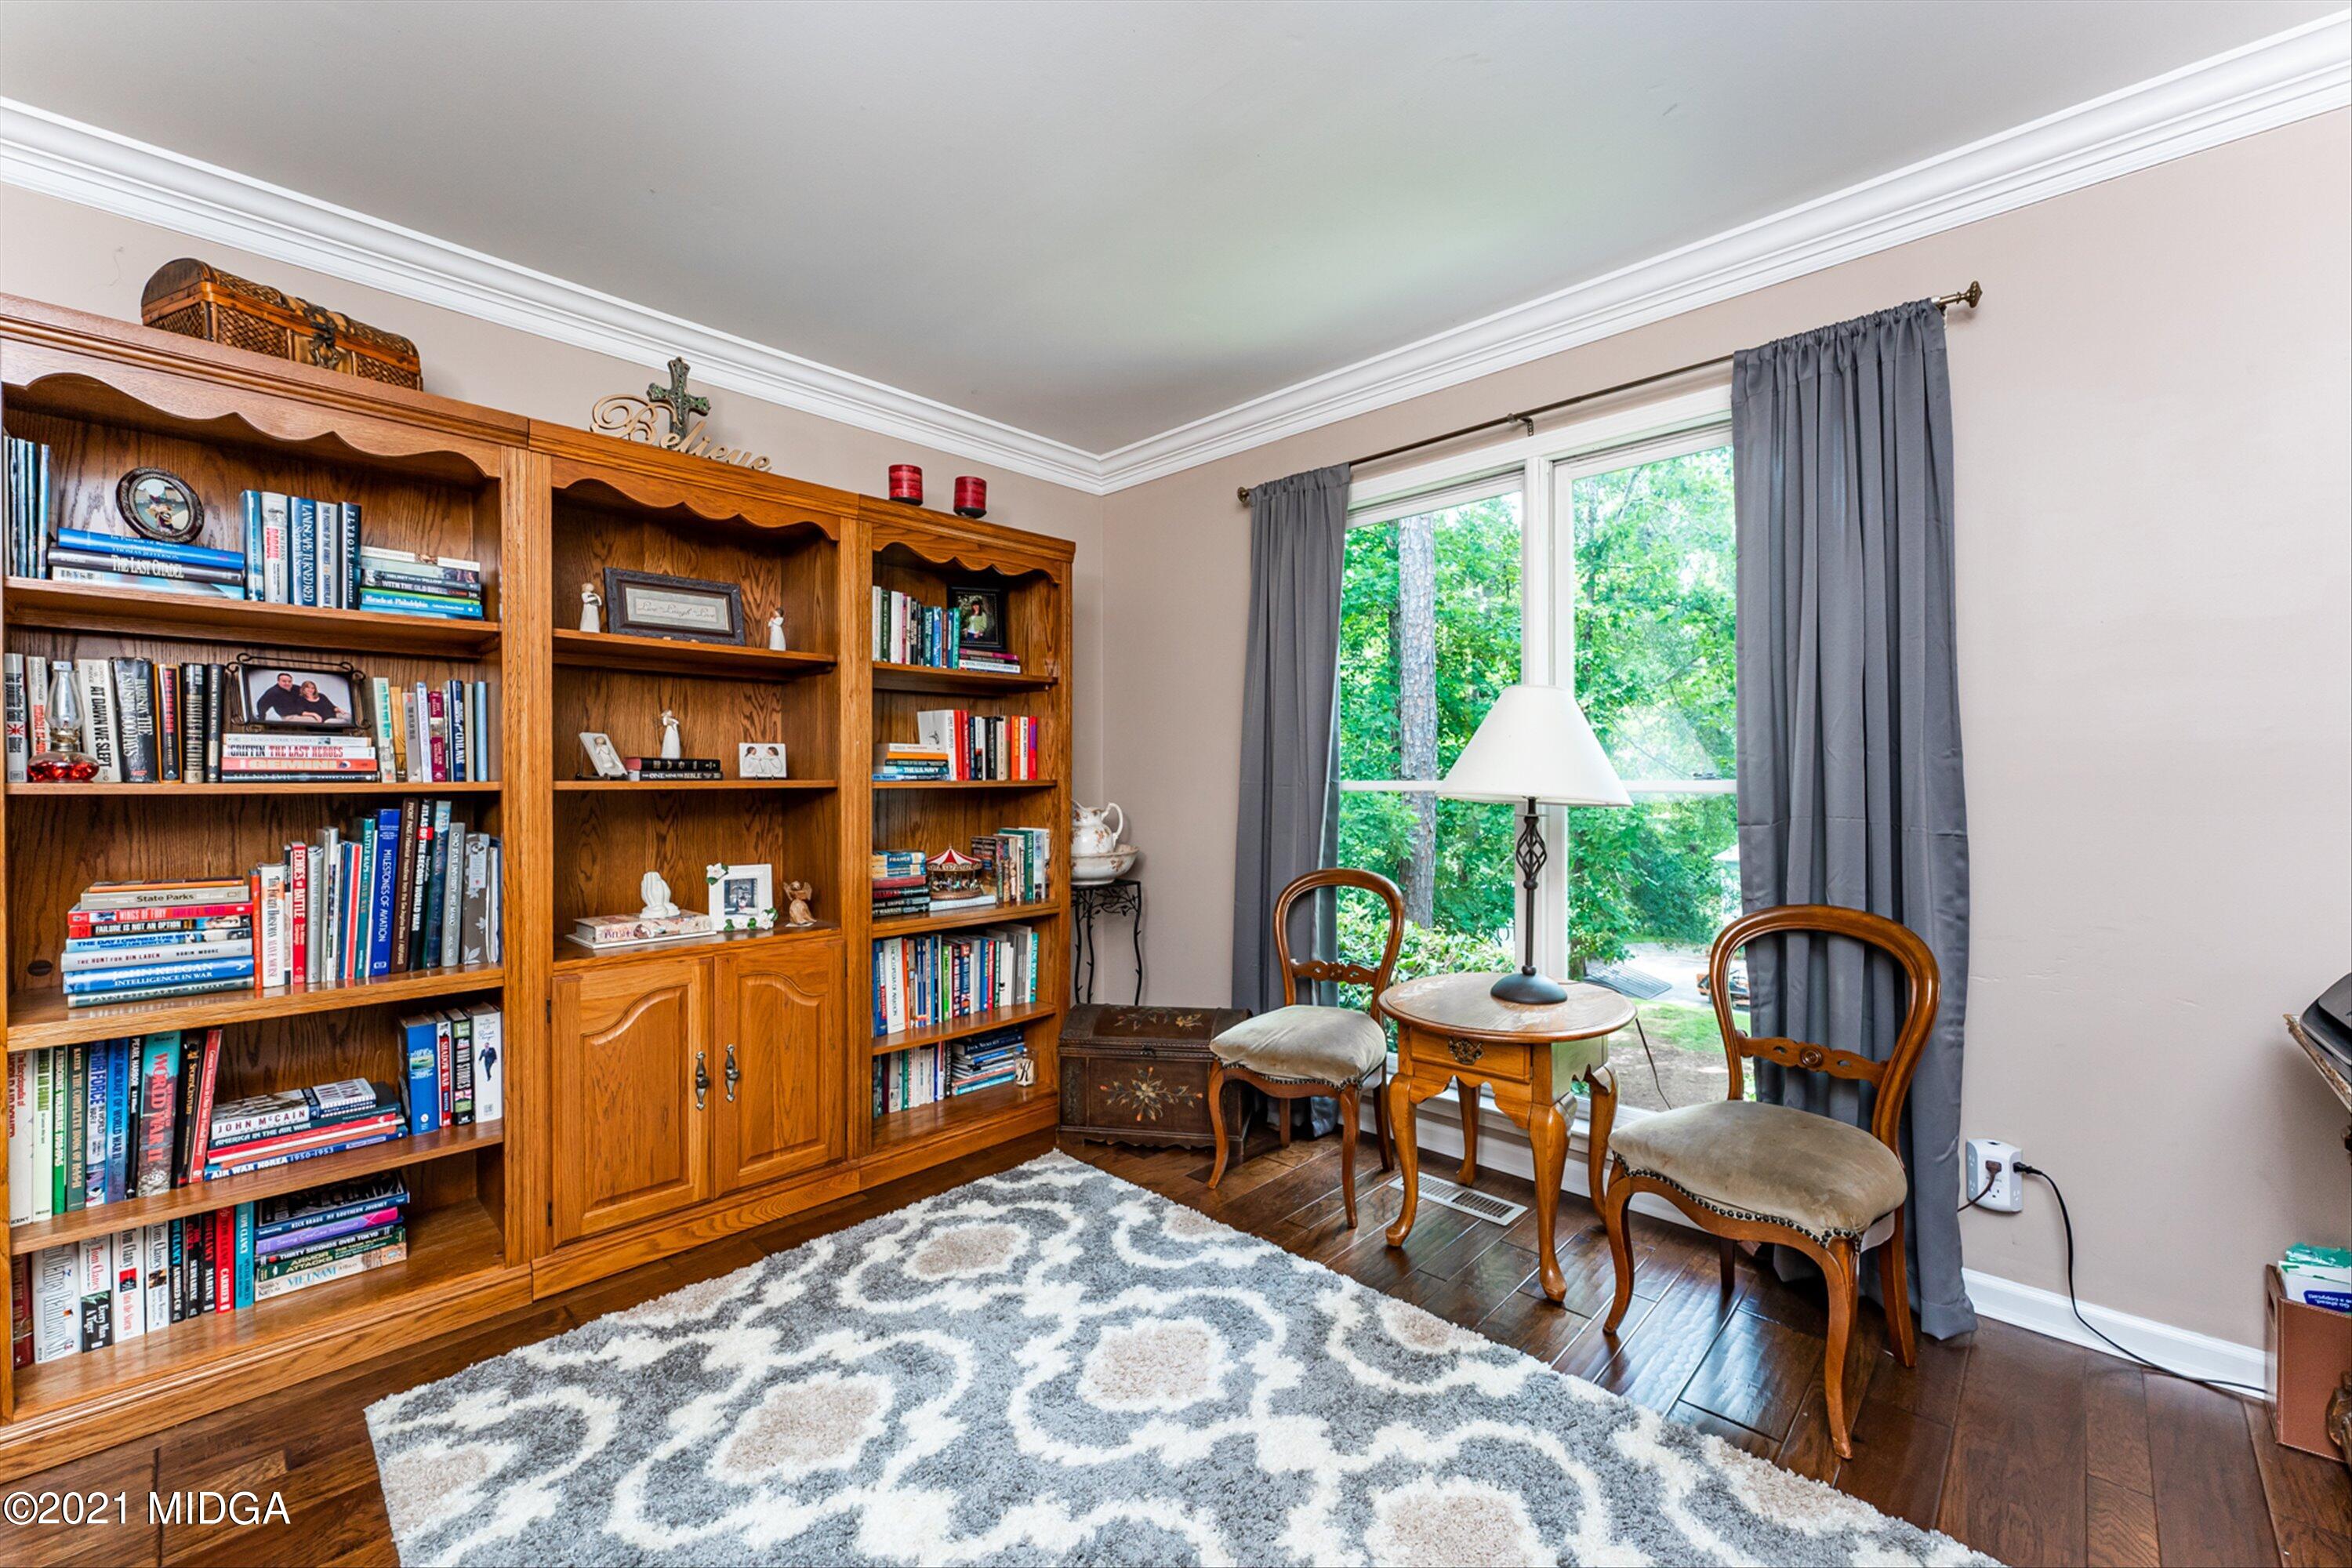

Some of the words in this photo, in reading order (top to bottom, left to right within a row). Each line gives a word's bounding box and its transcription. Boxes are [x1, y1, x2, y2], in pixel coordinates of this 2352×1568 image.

[590, 394, 772, 472] Believe
[302, 504, 314, 552] LANDSCAPE
[347, 510, 355, 559] FLYBOYS
[111, 554, 129, 573] THE
[129, 557, 151, 575] LAST
[152, 559, 185, 579] CITADEL
[303, 554, 314, 583] TURNED
[303, 584, 314, 602] RED
[382, 580, 400, 590] WITH
[415, 583, 426, 592] OLD
[90, 686, 104, 697] AT
[92, 699, 108, 724] DAWN
[94, 727, 110, 740] WE
[137, 715, 153, 735] THE
[96, 742, 112, 768] SLEPT
[230, 745, 265, 757] GRIFFIN
[269, 746, 288, 757] THE
[289, 746, 309, 757] LAST
[311, 746, 343, 758] HEROES
[456, 750, 464, 764] WAR
[248, 760, 337, 769] GEMINI
[419, 804, 429, 826] ATLAS
[419, 828, 427, 838] OF
[404, 836, 412, 858] Historical
[417, 839, 427, 853] THE
[293, 850, 305, 880] ECHOES
[381, 849, 392, 895] MILESTONES
[415, 855, 426, 884] SECOND
[450, 865, 459, 892] UNIVERSITY
[136, 895, 165, 904] State
[293, 888, 305, 919] BATTLE
[381, 896, 390, 907] OF
[412, 886, 423, 913] WORLD
[119, 909, 140, 921] WINGS
[141, 909, 150, 920] OF
[152, 908, 167, 919] FURY
[412, 913, 420, 931] WAR
[95, 923, 121, 934] FAILURE
[122, 922, 130, 931] IS
[131, 921, 144, 931] NOT
[147, 921, 156, 930] AN
[158, 920, 181, 930] OPTION
[379, 909, 389, 942] AVIATION
[154, 963, 213, 975] KEEGAN
[114, 975, 181, 987] INTELLIGENCE
[132, 1037, 140, 1058] PEARL
[55, 1050, 64, 1091] AIRBORNE
[73, 1073, 82, 1087] THE
[113, 1062, 123, 1097] AIRCRAFT
[151, 1053, 168, 1109] WORLD
[1017, 1061, 1032, 1082] K
[17, 1064, 26, 1099] Encyclopedia
[90, 1073, 105, 1105] FORCE
[55, 1092, 64, 1131] WARFARE
[72, 1091, 83, 1128] COMPLETE
[113, 1099, 122, 1108] OF
[112, 1109, 122, 1134] WORLD
[148, 1111, 165, 1143] WAR
[200, 1120, 209, 1138] Football
[217, 1120, 252, 1134] JOHN
[72, 1129, 82, 1149] BOOK
[112, 1136, 122, 1153] WAR
[215, 1134, 250, 1147] AMERICA
[252, 1132, 260, 1141] IN
[261, 1130, 277, 1139] THE
[278, 1127, 292, 1137] AIR
[294, 1123, 312, 1134] WAR
[72, 1151, 82, 1160] OF
[147, 1149, 163, 1163] II
[211, 1170, 230, 1180] AIR
[232, 1164, 254, 1175] WAR
[256, 1157, 289, 1171] KOREA
[289, 1147, 334, 1162] 1950-1953
[240, 1213, 249, 1228] TOM
[291, 1220, 305, 1229] RICK
[306, 1216, 323, 1225] BRAGG
[336, 1207, 363, 1218] SOUTHERN
[365, 1202, 387, 1212] JOURNEY
[122, 1229, 136, 1244] Tom
[154, 1224, 166, 1240] Tom
[239, 1229, 248, 1254] CLANCY
[277, 1236, 299, 1246] Saving
[91, 1245, 104, 1263] Tom
[153, 1243, 166, 1269] Clancy
[280, 1250, 305, 1260] THIRTY
[306, 1241, 337, 1254] SECONDS
[338, 1237, 356, 1246] OVER
[357, 1231, 379, 1241] TOKYO
[120, 1245, 136, 1269] Clancy
[285, 1256, 333, 1273] ATTACKS
[290, 1251, 329, 1266] ARMOR
[90, 1265, 104, 1291] Clancy
[189, 1259, 198, 1301] SUBMARINE
[205, 1268, 214, 1301] MARINE
[220, 1268, 230, 1303] CARRIER
[288, 1266, 338, 1286] VIETNAM
[95, 1305, 109, 1323] Every
[83, 1316, 96, 1334] Tiger
[99, 1323, 110, 1339] Man
